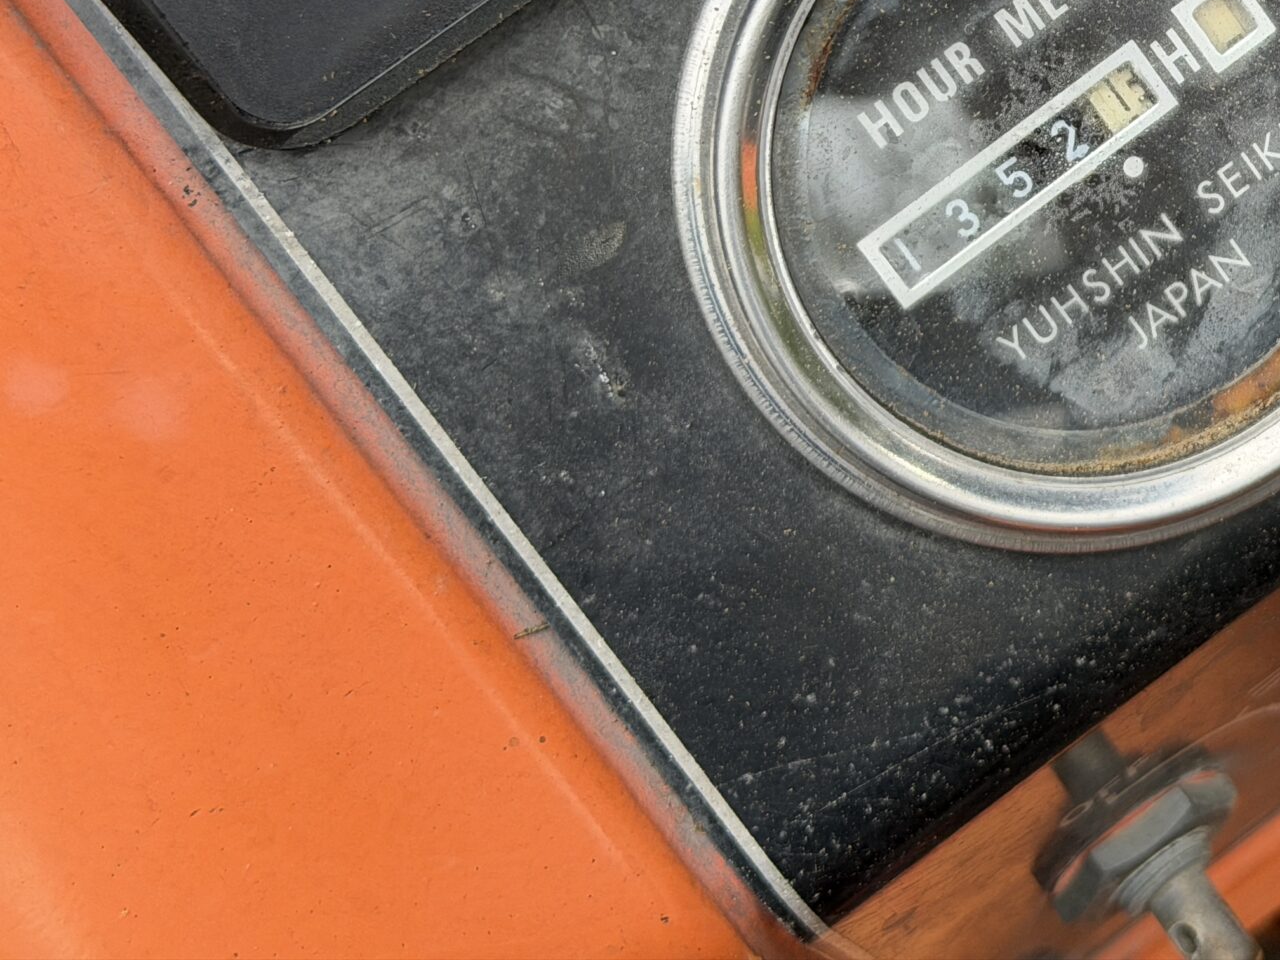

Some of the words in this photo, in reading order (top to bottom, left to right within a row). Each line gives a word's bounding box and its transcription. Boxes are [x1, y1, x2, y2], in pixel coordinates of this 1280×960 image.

[857, 41, 986, 149] HOUR
[1150, 26, 1201, 85] H
[996, 213, 1184, 360] YUHSHIN
[1127, 238, 1252, 349] JAPAN
